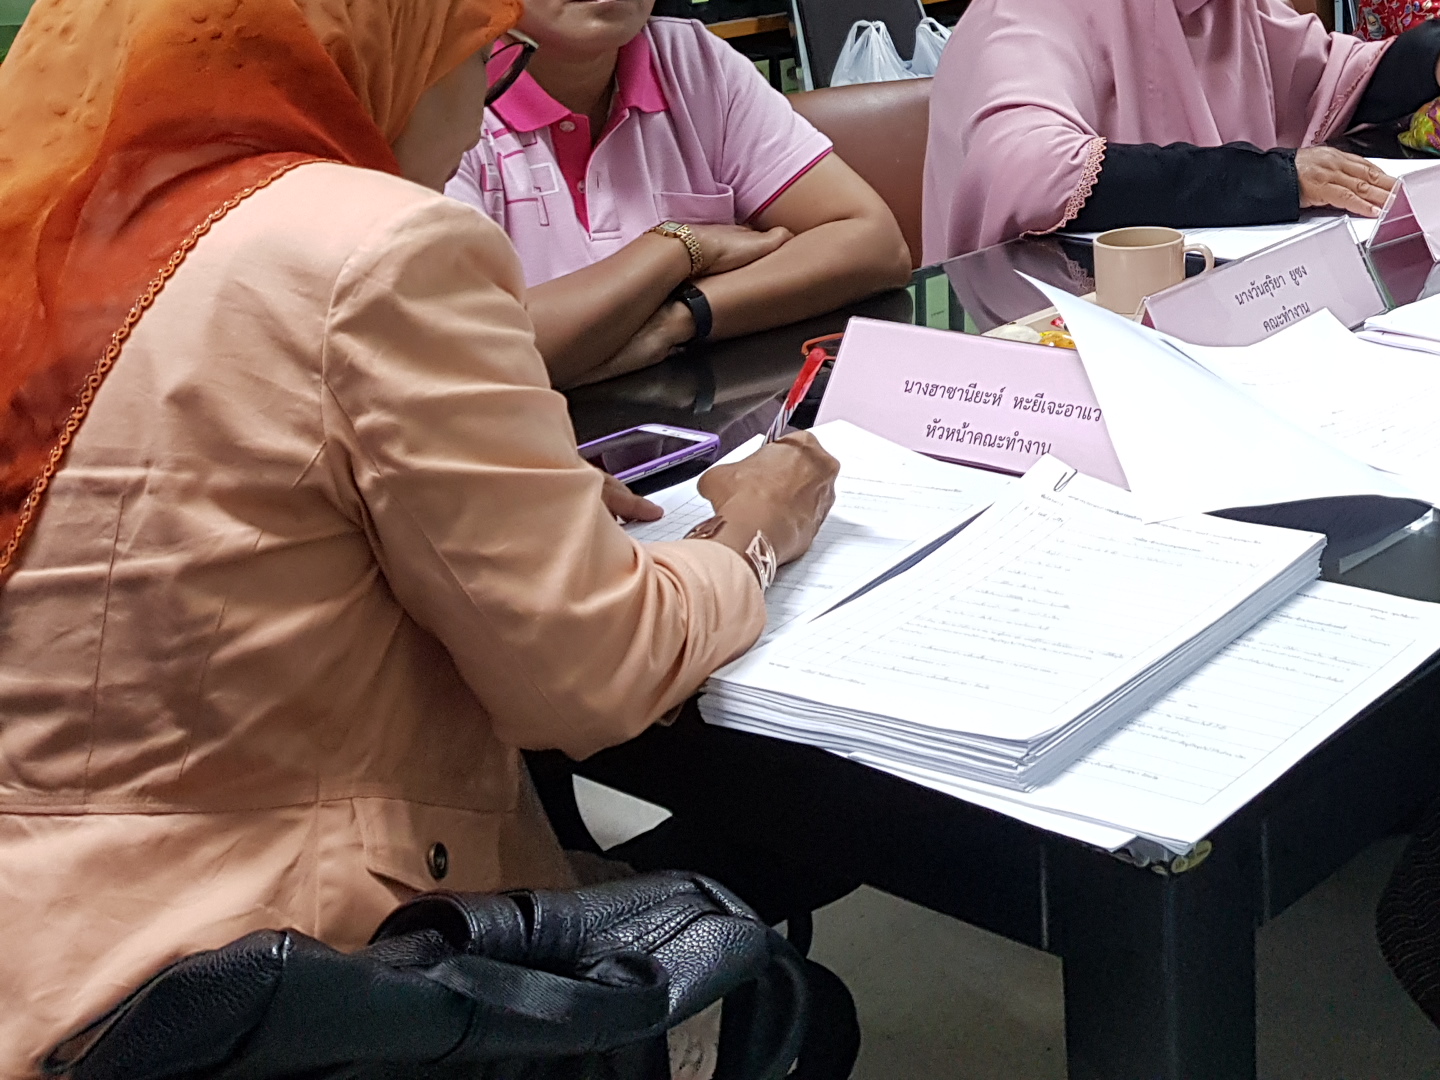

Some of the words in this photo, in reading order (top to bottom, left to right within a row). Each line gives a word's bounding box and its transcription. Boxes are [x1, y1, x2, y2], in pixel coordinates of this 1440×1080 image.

[1234, 274, 1287, 306] นางวันสุริยา
[1263, 301, 1311, 333] คณะทำงาน
[1013, 392, 1102, 422] หะยีเจะอาแว
[926, 418, 1052, 456] หัวหน้าคณะทำงาน
